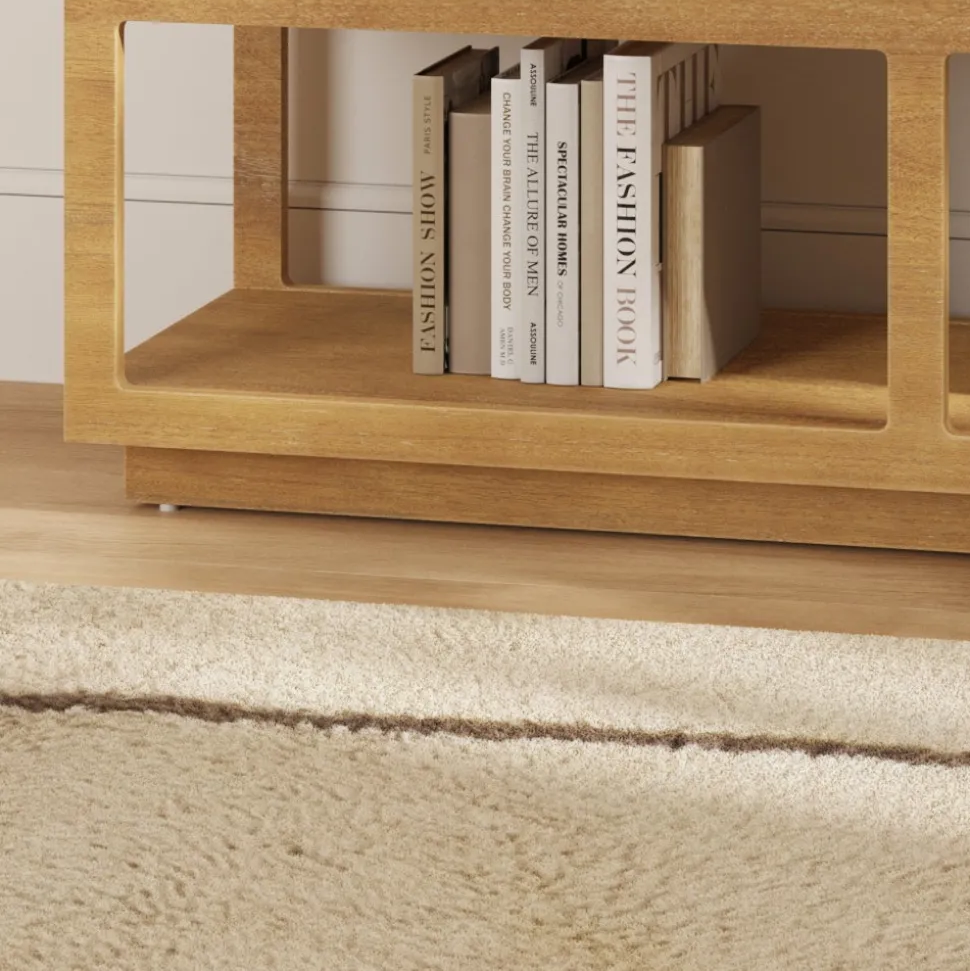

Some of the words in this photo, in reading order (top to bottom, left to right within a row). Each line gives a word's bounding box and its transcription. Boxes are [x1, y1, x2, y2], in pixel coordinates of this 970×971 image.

[530, 63, 538, 106] ASSOULINE
[616, 72, 636, 136] THE
[501, 92, 512, 135] CHANGE
[501, 138, 512, 167] YOUR
[527, 132, 538, 164] THE
[420, 171, 436, 240] SHOW
[501, 169, 512, 201] BRAIN
[527, 167, 538, 232] ALLURE
[557, 141, 567, 228] SPECTACULAR
[501, 204, 512, 248] CHANGE
[616, 146, 636, 277] FASHION
[501, 251, 512, 279] YOUR
[527, 235, 538, 257] OF
[557, 233, 567, 276] HOMES
[501, 282, 512, 310] BODY
[527, 261, 538, 297] MEN
[419, 251, 436, 352] FASHION
[530, 322, 538, 365] ASSOULINE
[616, 288, 636, 366] BOOK
